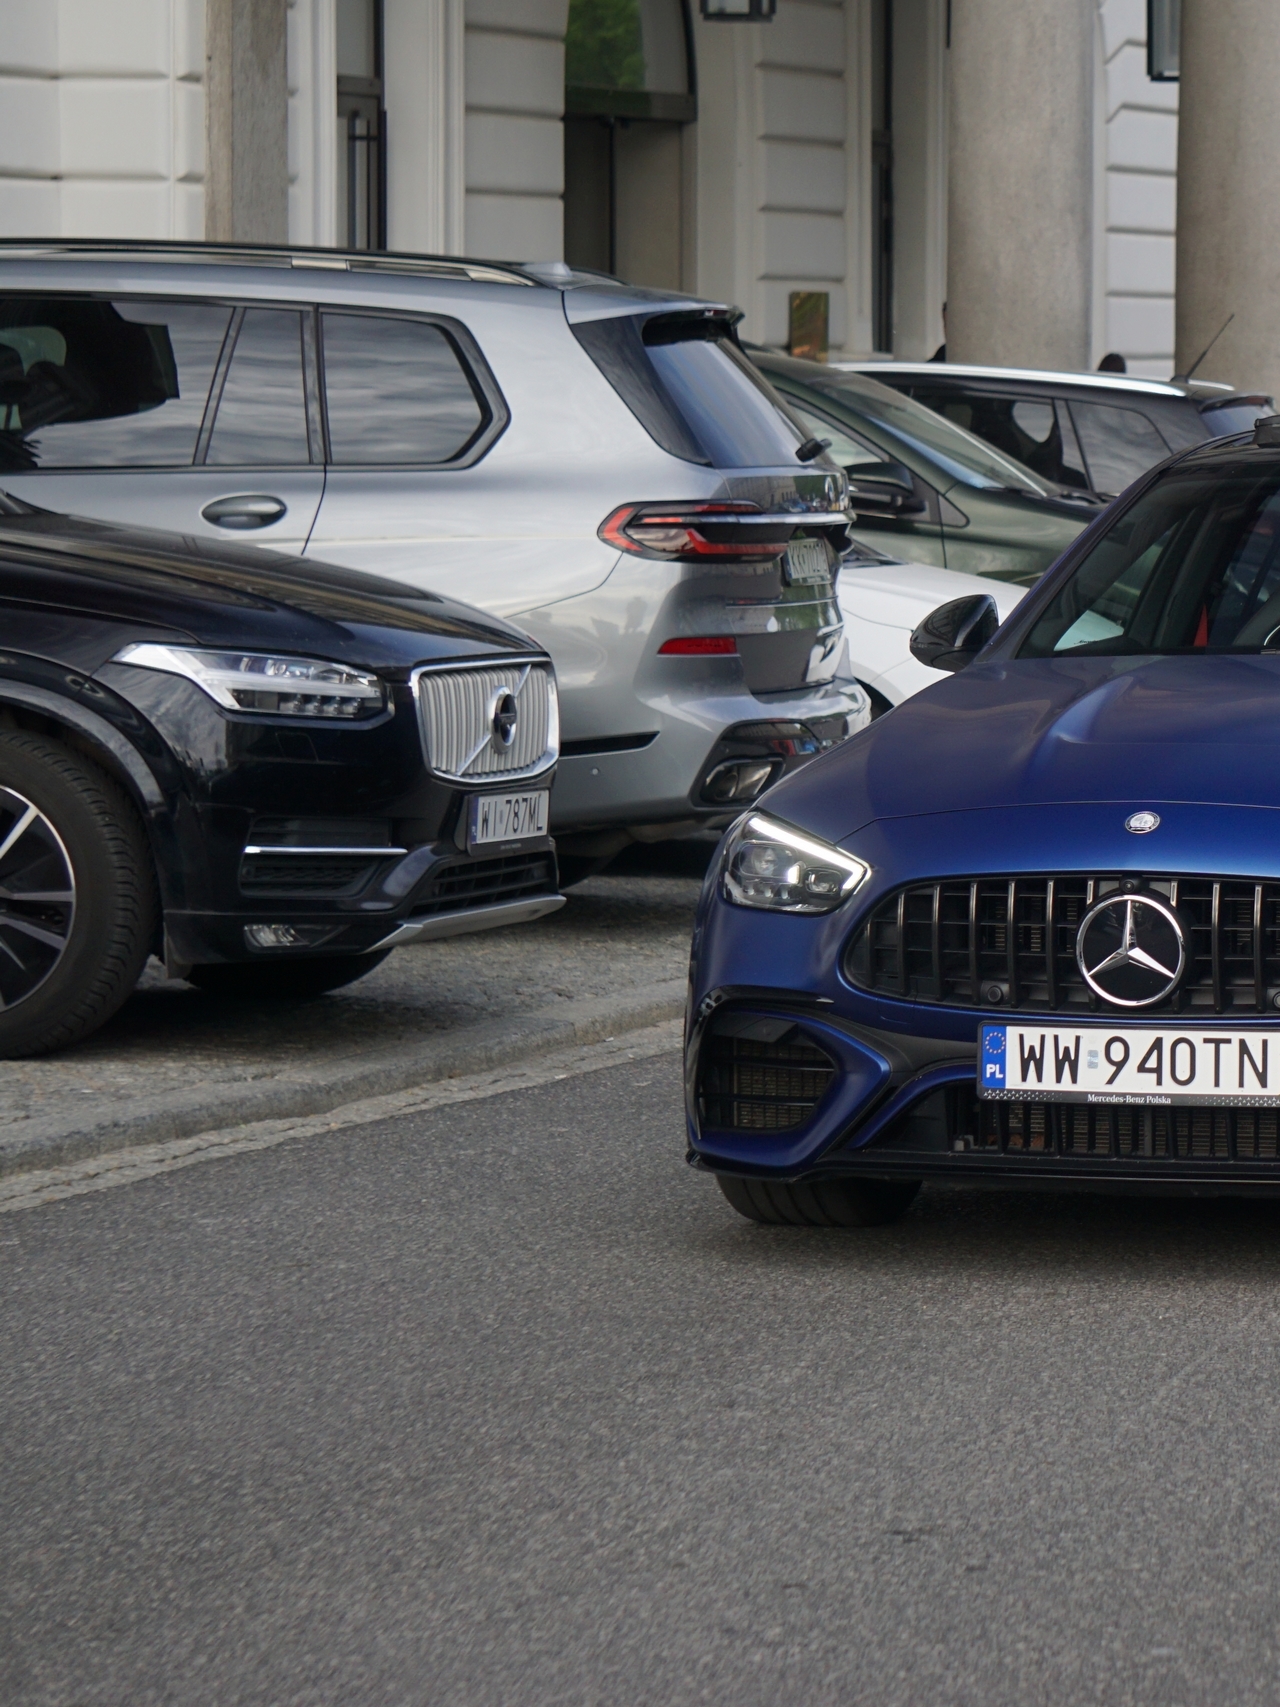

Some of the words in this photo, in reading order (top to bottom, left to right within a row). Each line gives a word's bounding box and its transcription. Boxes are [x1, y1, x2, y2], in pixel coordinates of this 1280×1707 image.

[481, 800, 498, 839] WI
[504, 794, 543, 836] 787ML
[985, 1063, 1004, 1079] PL
[1018, 1033, 1081, 1085] WW
[1104, 1036, 1269, 1089] 940TN
[1087, 1093, 1146, 1104] Mercedes-Benz
[1146, 1095, 1171, 1105] Polska
